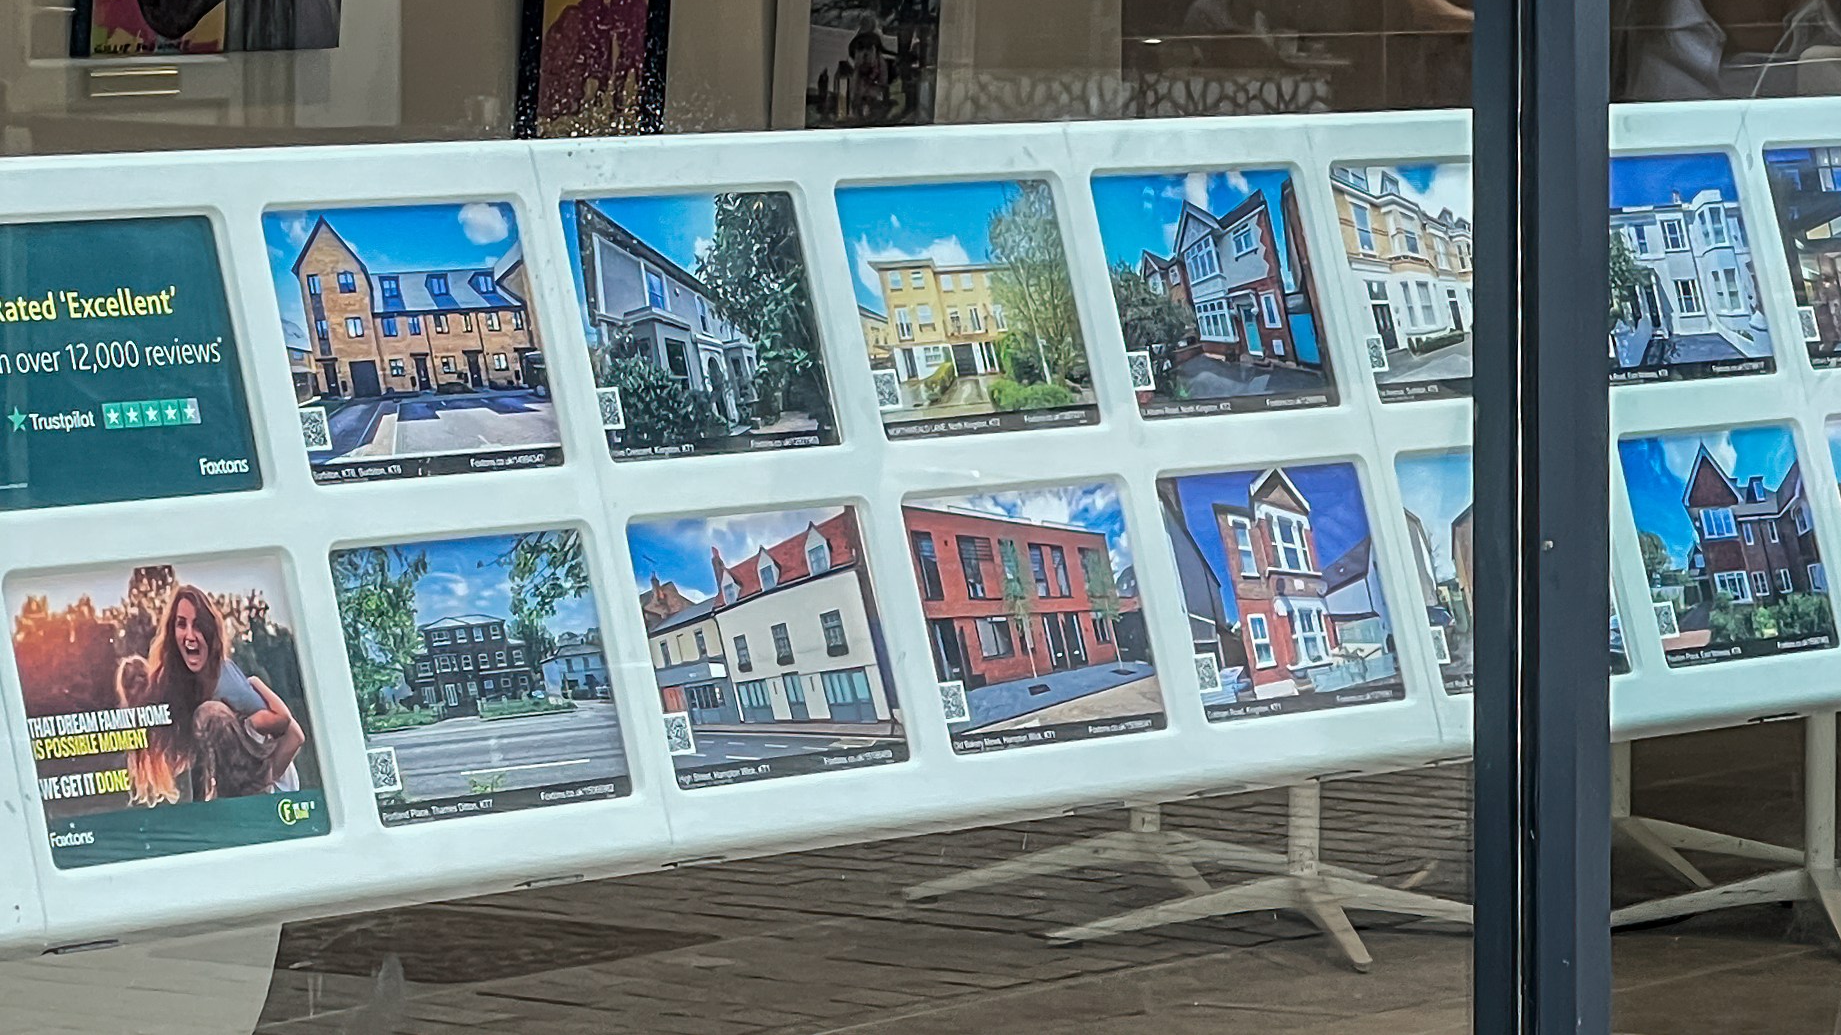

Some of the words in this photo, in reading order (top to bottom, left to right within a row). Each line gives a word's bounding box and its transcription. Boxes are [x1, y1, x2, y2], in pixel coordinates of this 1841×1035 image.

[60, 285, 176, 319] 'Excellent'
[16, 351, 60, 373] over
[65, 340, 140, 374] 12,000
[29, 411, 96, 432] Trustpilot
[199, 457, 250, 476] Foxtons
[27, 715, 57, 739] THAT
[55, 711, 98, 736] DREAM
[98, 706, 137, 732] FAMILY
[136, 704, 172, 727] HOME
[44, 733, 99, 760] POSSIBLE
[97, 728, 149, 753] MOMENT
[60, 773, 85, 798] GET
[83, 772, 97, 796] IT
[94, 768, 131, 794] DONE
[49, 831, 95, 848] Foxtons
